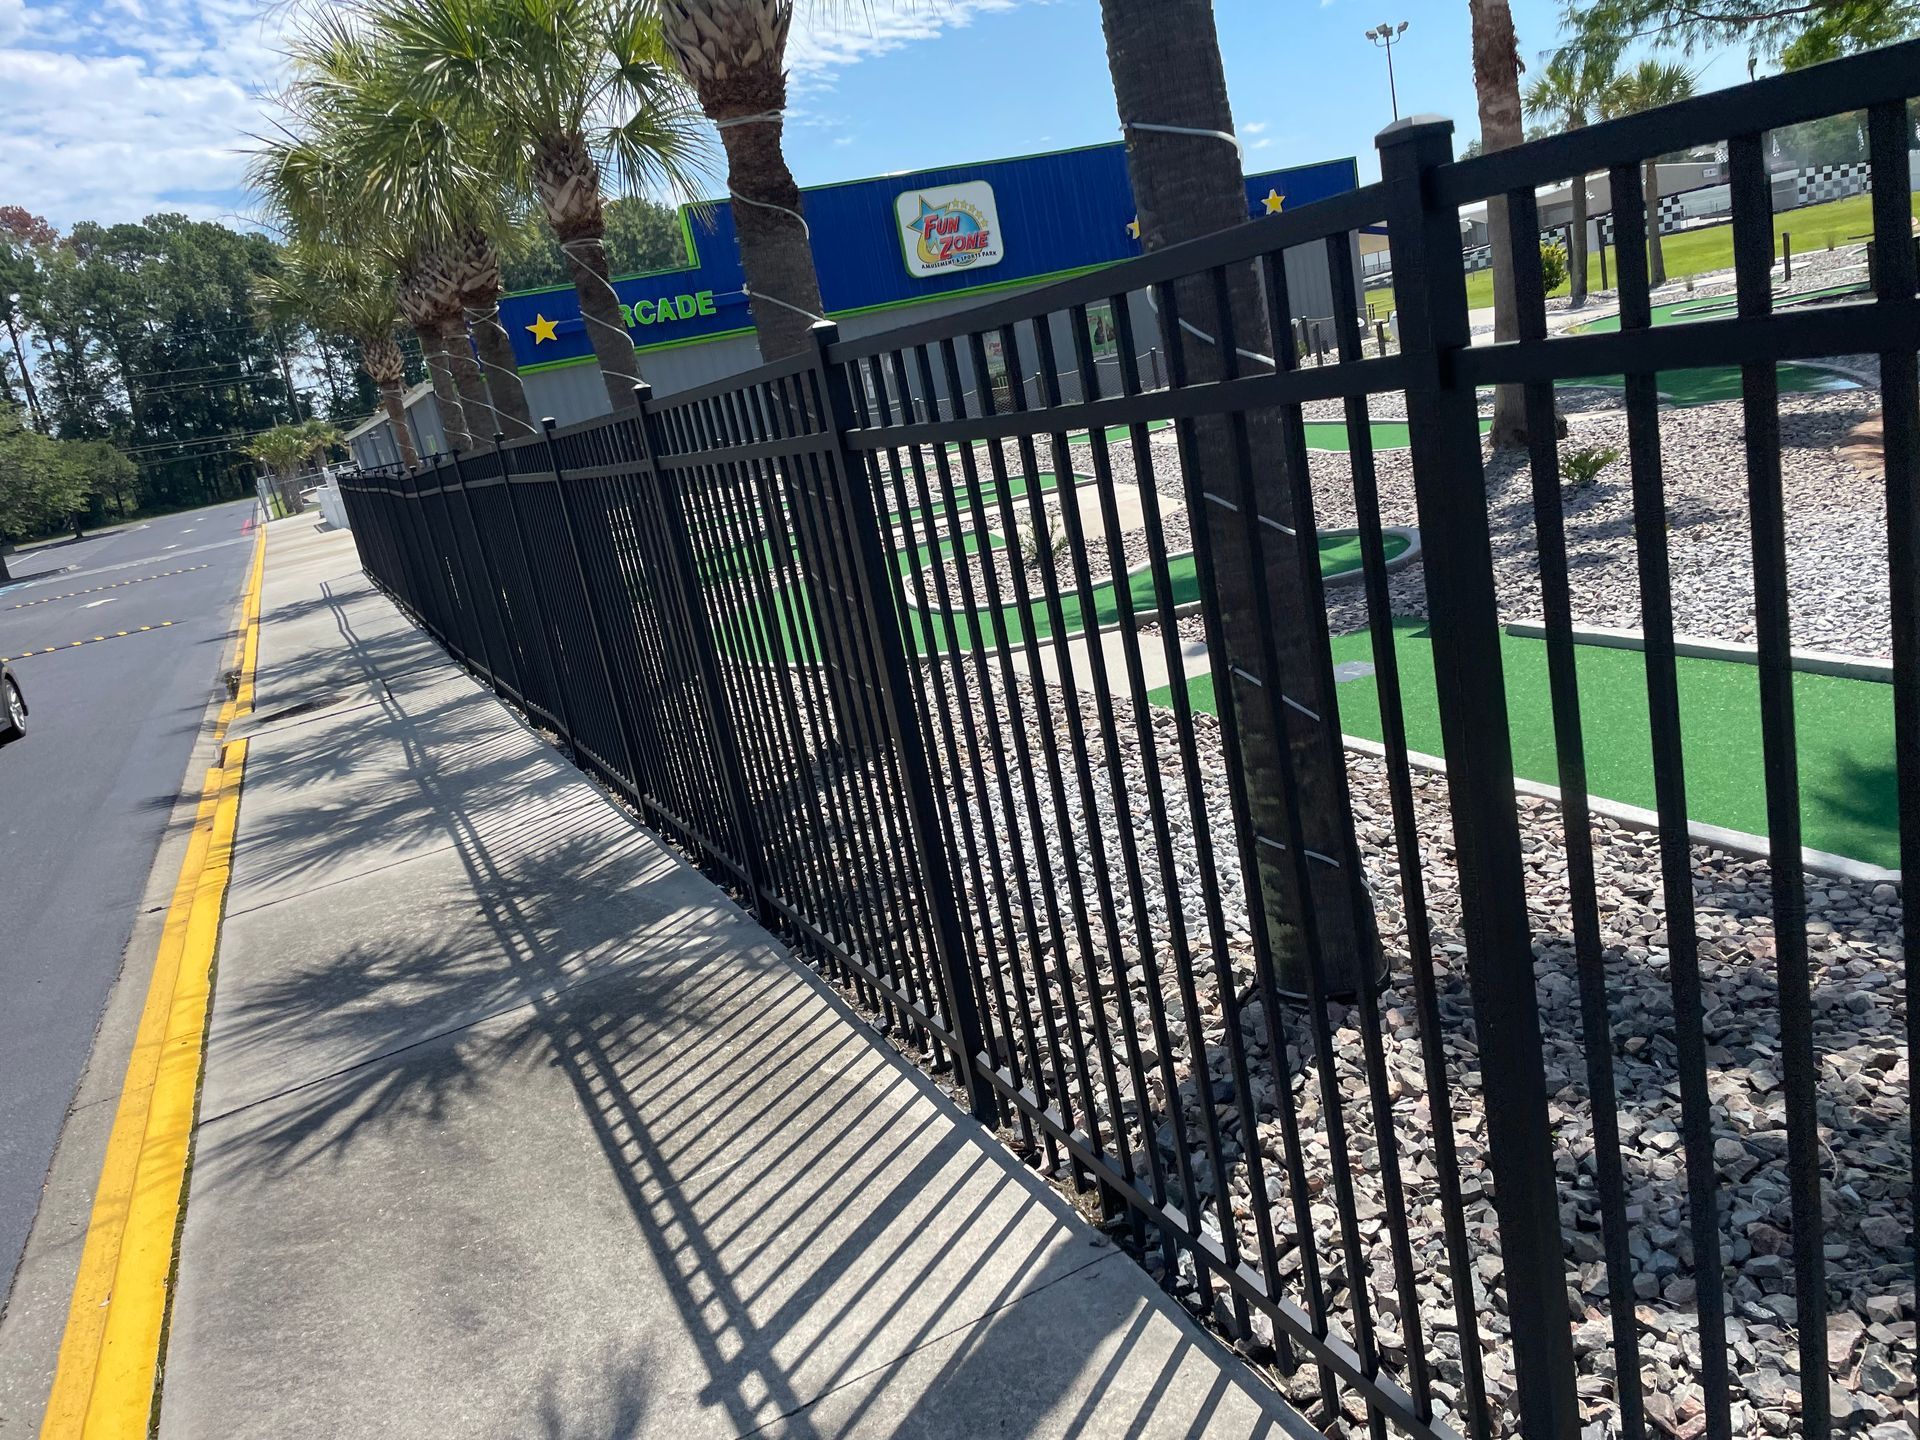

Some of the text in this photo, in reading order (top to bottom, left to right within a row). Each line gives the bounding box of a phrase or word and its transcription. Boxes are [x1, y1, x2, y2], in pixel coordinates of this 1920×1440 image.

[924, 214, 959, 240] FUN
[940, 230, 989, 260] ZONE
[921, 259, 955, 269] AMUSEMENT
[961, 253, 981, 262] SPORTS
[617, 290, 717, 328] RCADE
